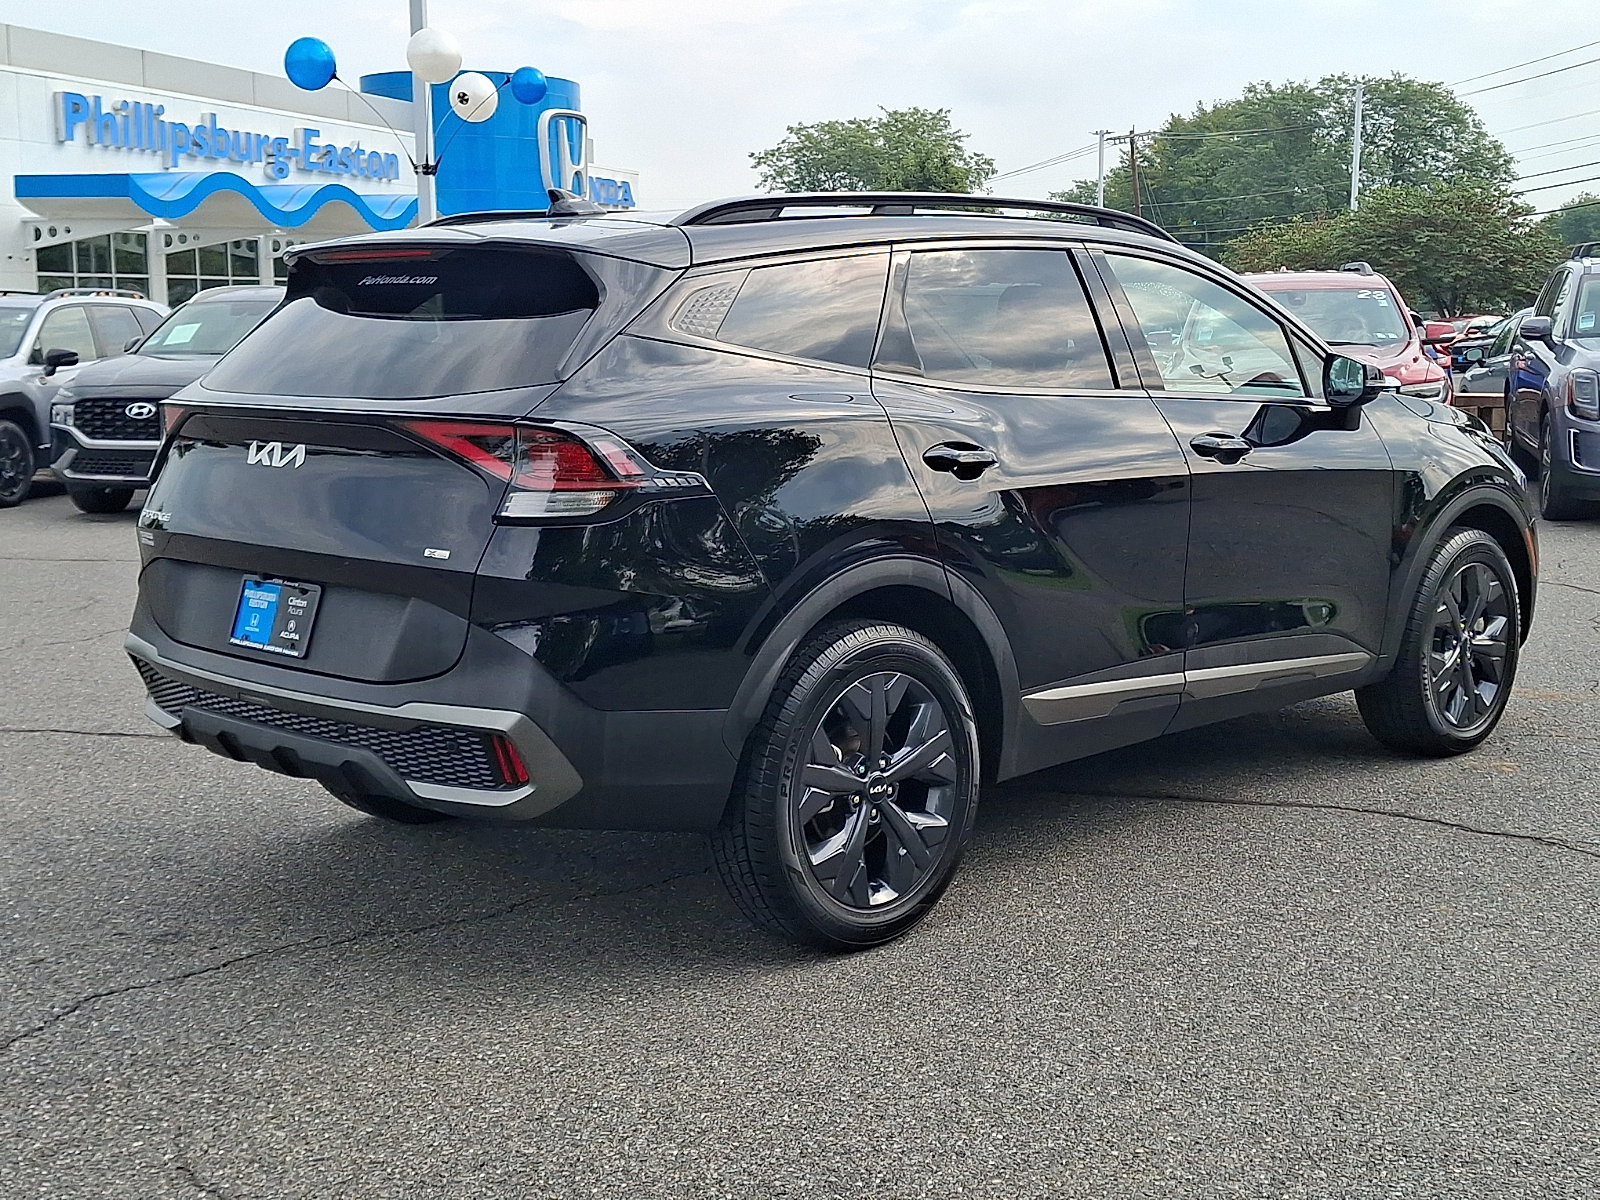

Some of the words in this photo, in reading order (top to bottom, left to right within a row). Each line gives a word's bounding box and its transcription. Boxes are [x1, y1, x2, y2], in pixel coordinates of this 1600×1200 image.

[55, 91, 400, 180] Phillipsburg-Easton
[588, 175, 635, 207] NDA
[1357, 289, 1387, 300] 23
[246, 440, 307, 469] KIA
[280, 631, 299, 640] ACURA
